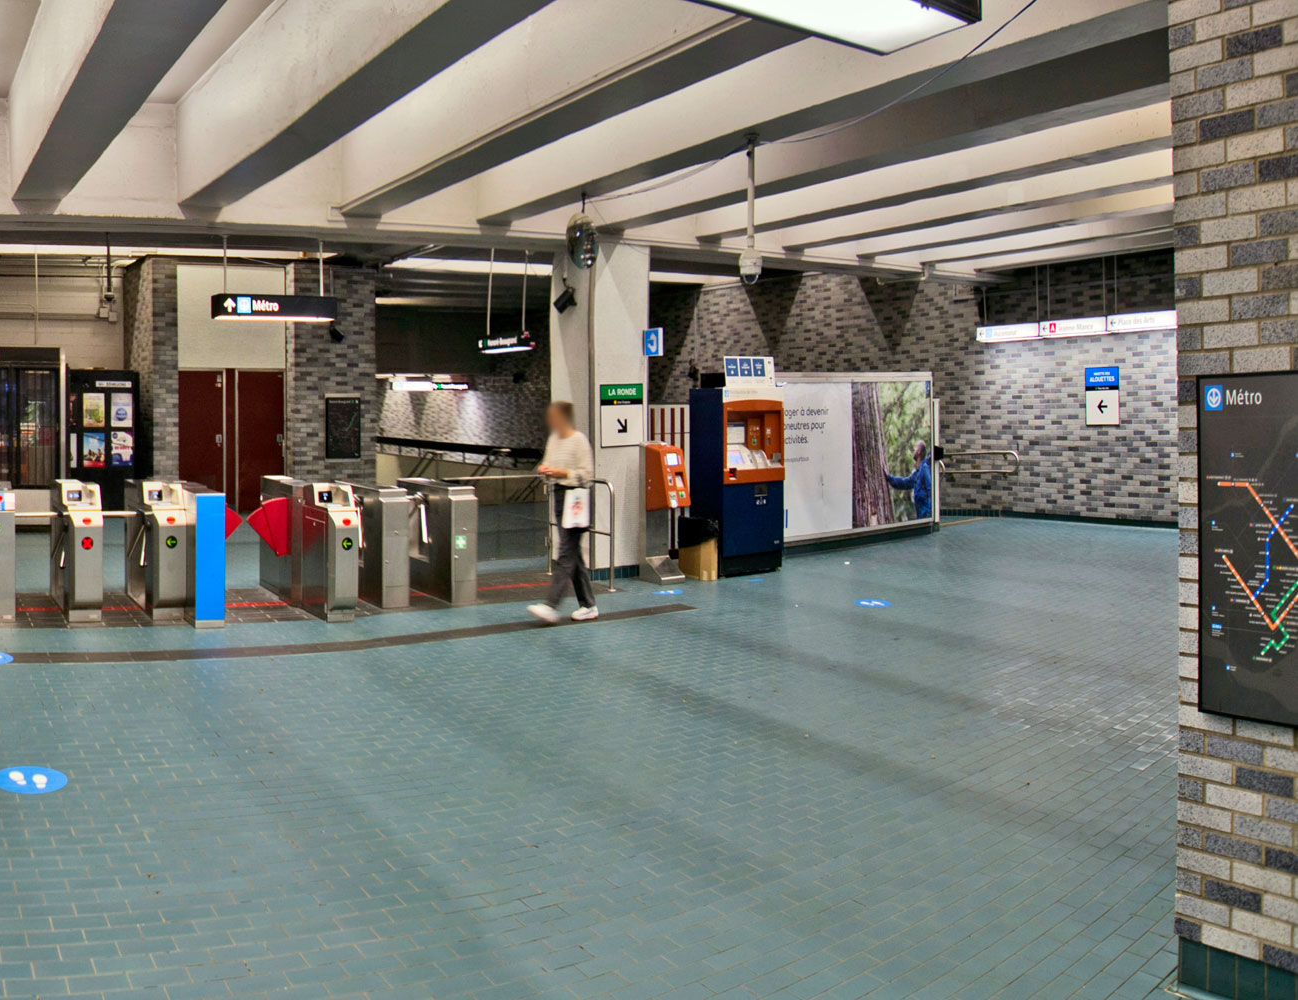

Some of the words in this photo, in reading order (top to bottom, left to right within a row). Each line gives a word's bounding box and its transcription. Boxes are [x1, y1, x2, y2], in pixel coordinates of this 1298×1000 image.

[252, 300, 280, 312] Métro
[607, 388, 616, 396] LA
[617, 388, 636, 396] RONDE
[1226, 388, 1263, 405] Métro
[806, 406, 829, 416] devenir
[810, 421, 825, 432] pour
